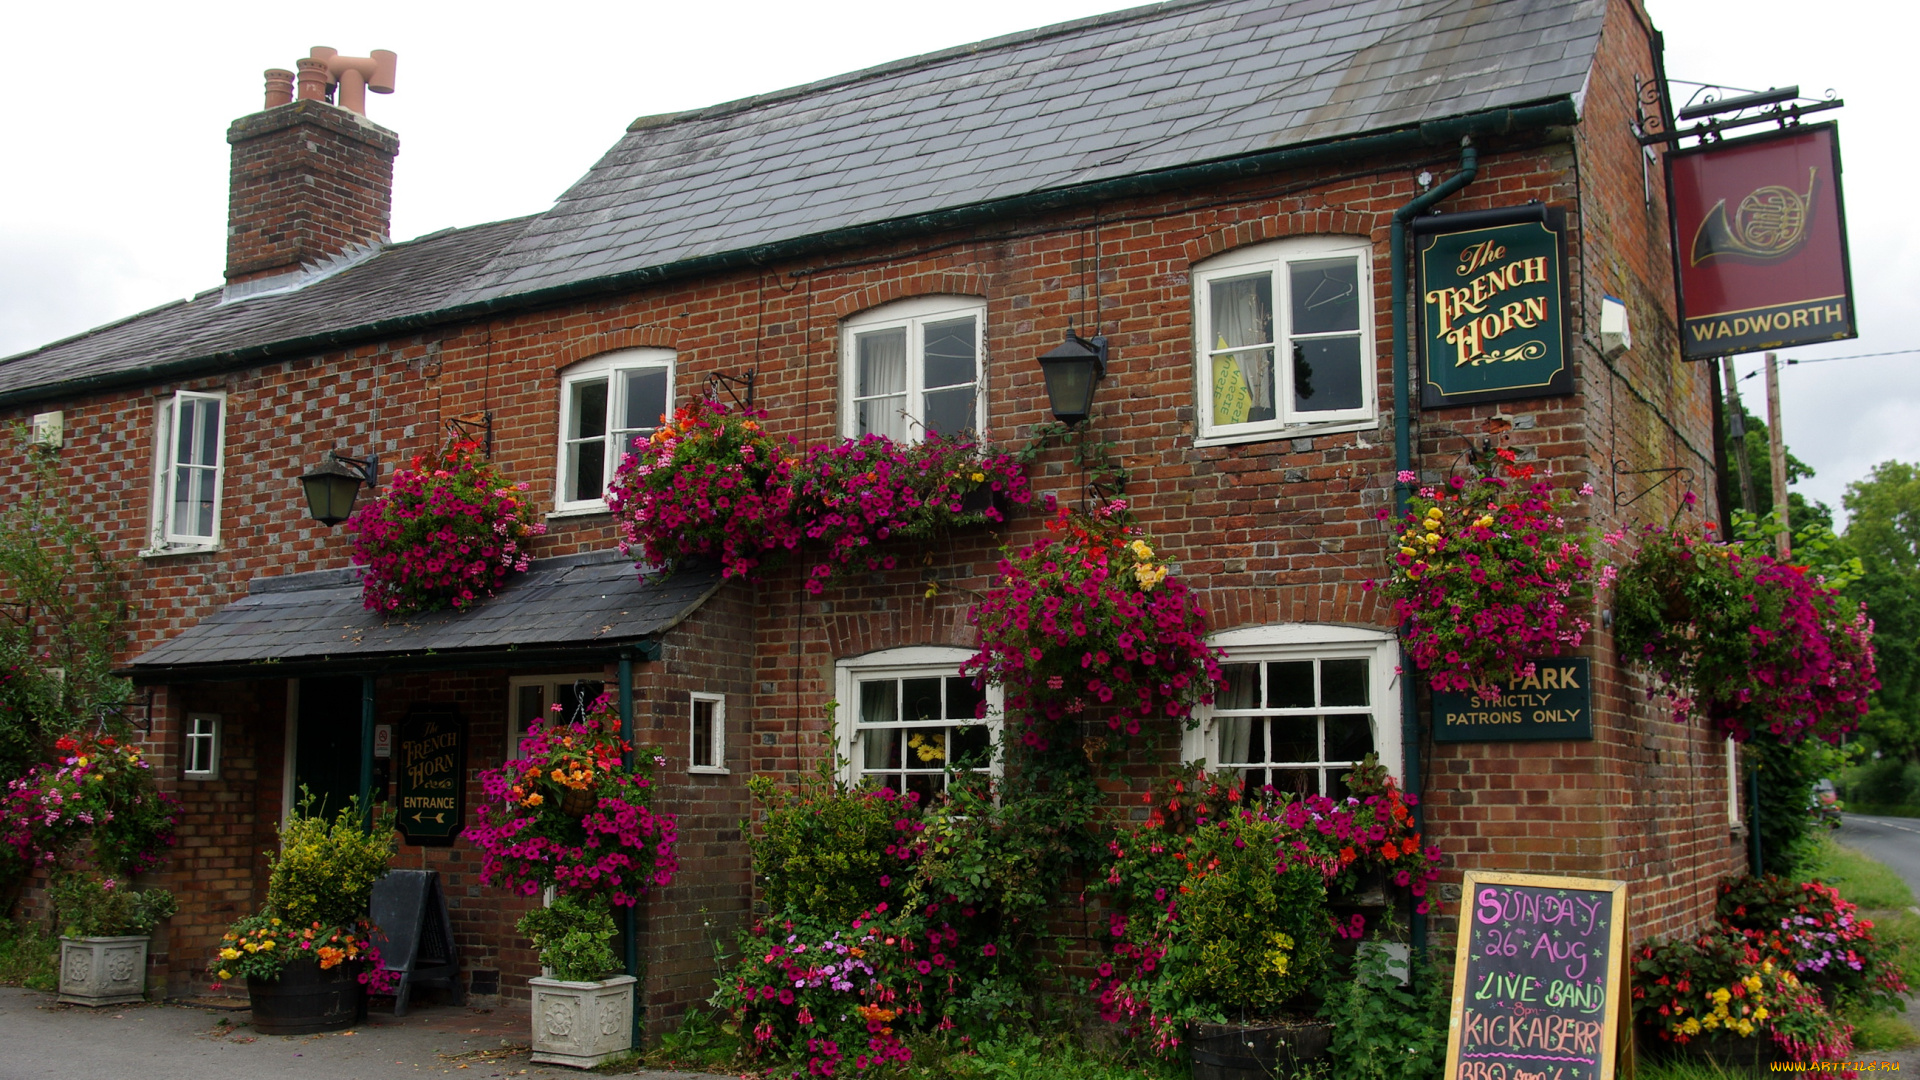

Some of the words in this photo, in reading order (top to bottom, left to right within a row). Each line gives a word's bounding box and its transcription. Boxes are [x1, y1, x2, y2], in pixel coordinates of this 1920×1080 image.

[1456, 239, 1506, 276] The
[1426, 256, 1548, 339] FRENCH
[1446, 296, 1548, 367] HORN
[1691, 303, 1842, 342] WADWORTH
[1509, 667, 1580, 691] PARK
[1446, 711, 1522, 726] PATRONS
[1533, 708, 1581, 723] ONLY
[402, 732, 457, 768] FRENCH
[407, 753, 455, 790] HORN
[403, 796, 455, 809] ENTRANCE
[1477, 888, 1602, 936] SUNDAY
[1475, 972, 1537, 1002] LIVE
[1544, 979, 1605, 1013] BAND
